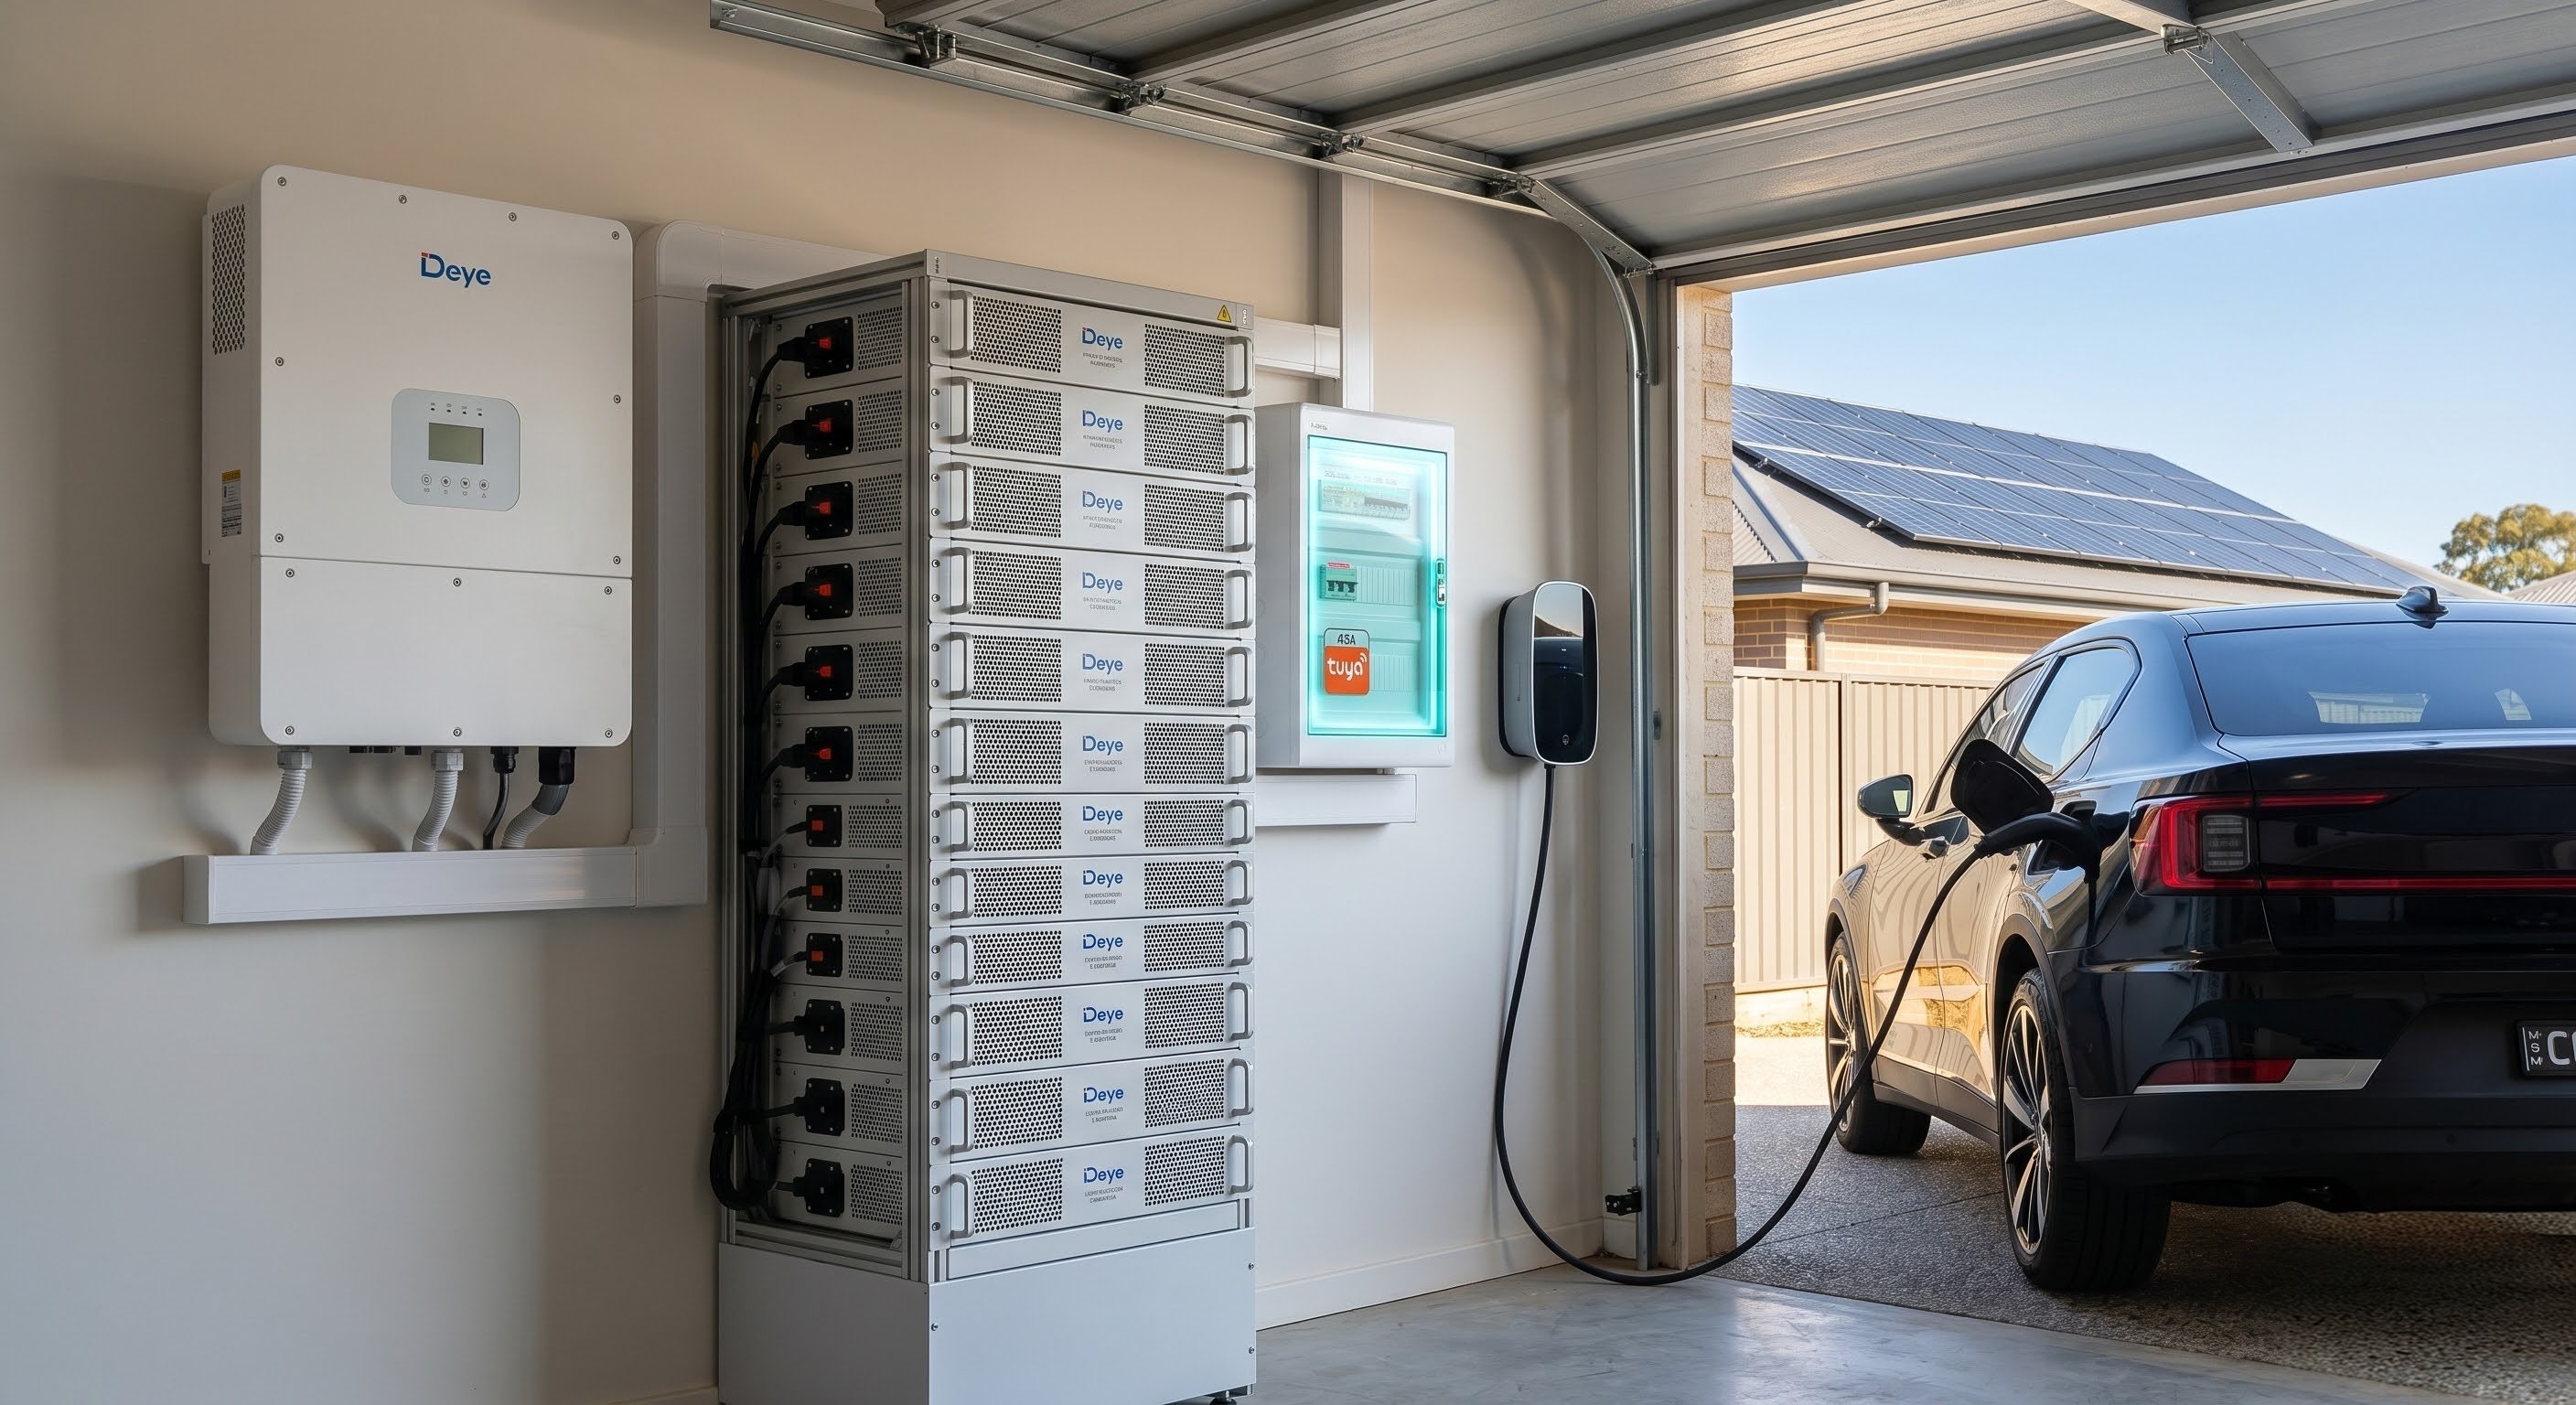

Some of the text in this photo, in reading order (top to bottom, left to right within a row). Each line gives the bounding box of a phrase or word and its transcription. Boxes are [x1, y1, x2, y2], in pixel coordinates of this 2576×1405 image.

[421, 252, 491, 288] Deye
[1081, 327, 1123, 351] Deye
[1082, 409, 1123, 434] Deye
[1082, 490, 1123, 514] Deye
[1082, 572, 1123, 595] Deye
[1082, 653, 1123, 675] Deye
[1326, 657, 1363, 681] tuya
[1082, 735, 1123, 756] Deye
[1082, 805, 1124, 825] Deye
[1082, 869, 1124, 888] Deye
[1082, 933, 1124, 952] Deye
[1082, 1006, 1124, 1024] Deye
[2547, 1030, 2576, 1066] C
[1083, 1086, 1124, 1105] Deye
[1083, 1165, 1125, 1185] Deye
